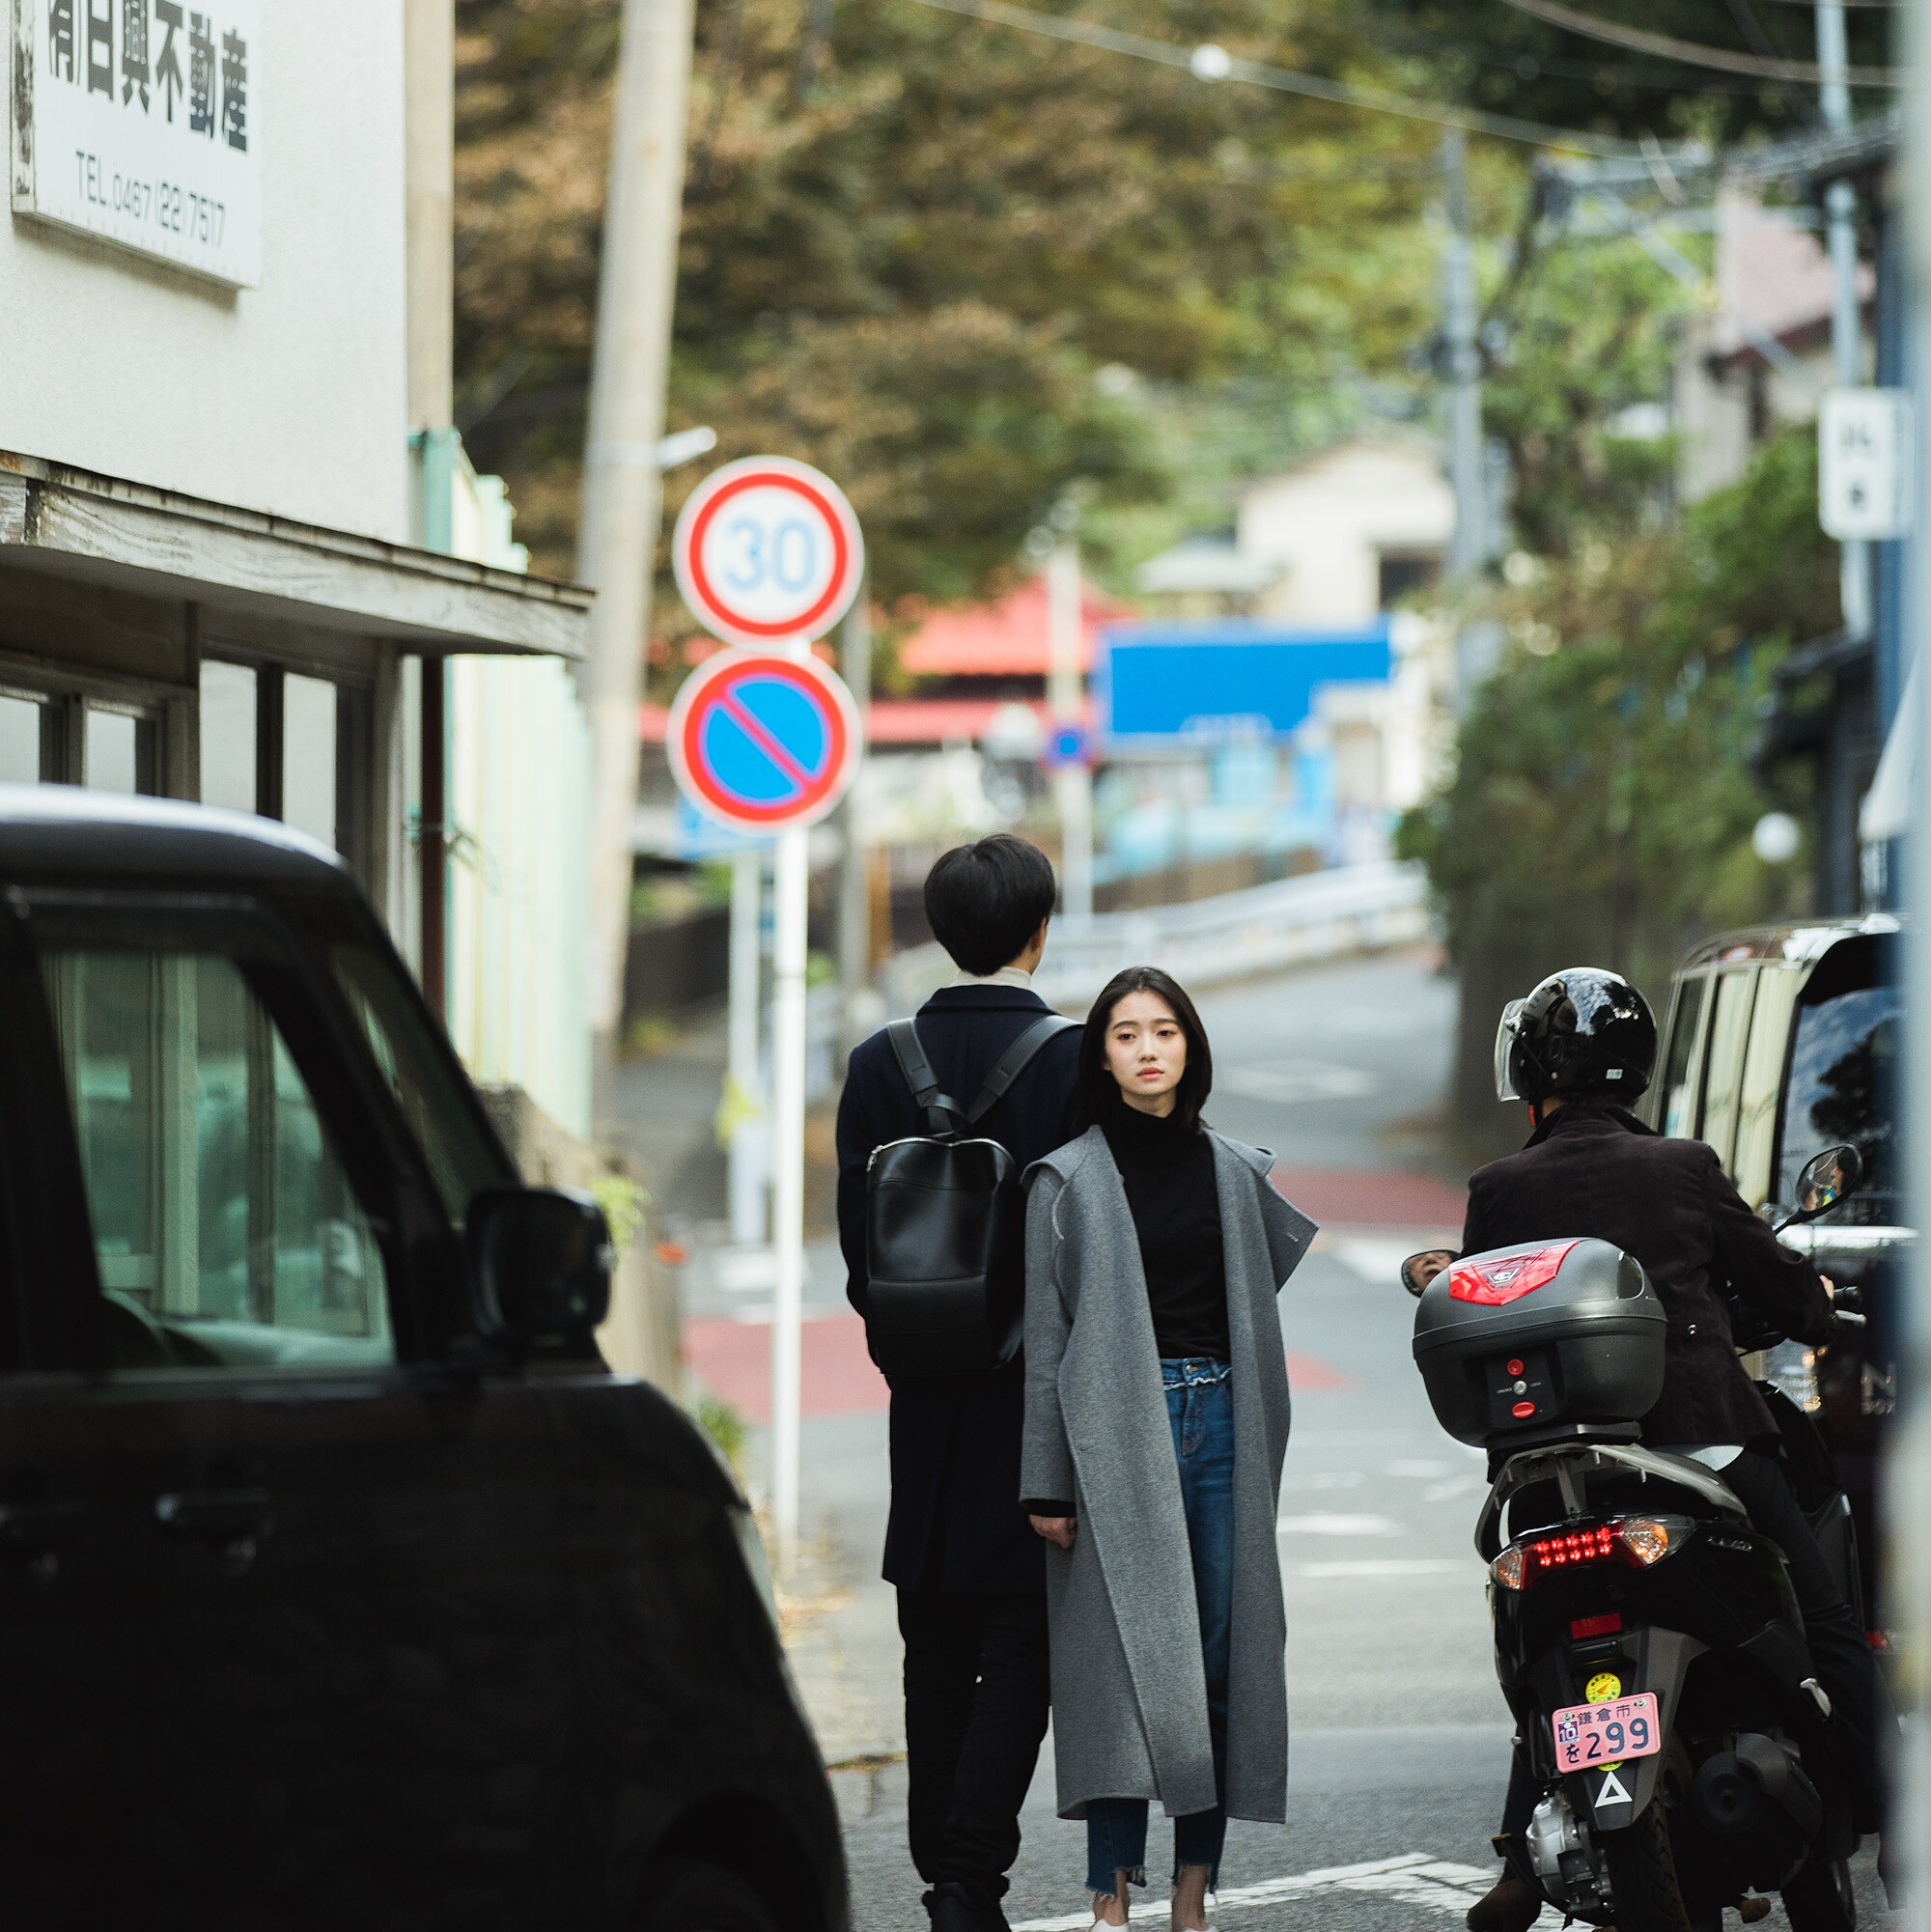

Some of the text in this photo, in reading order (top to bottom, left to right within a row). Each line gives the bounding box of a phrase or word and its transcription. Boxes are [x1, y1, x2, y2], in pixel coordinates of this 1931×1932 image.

[724, 518, 816, 593] 30
[1577, 1704, 1631, 1725] 鎌倉市
[1559, 1727, 1577, 1742] 10
[1566, 1718, 1649, 1764] を 299
